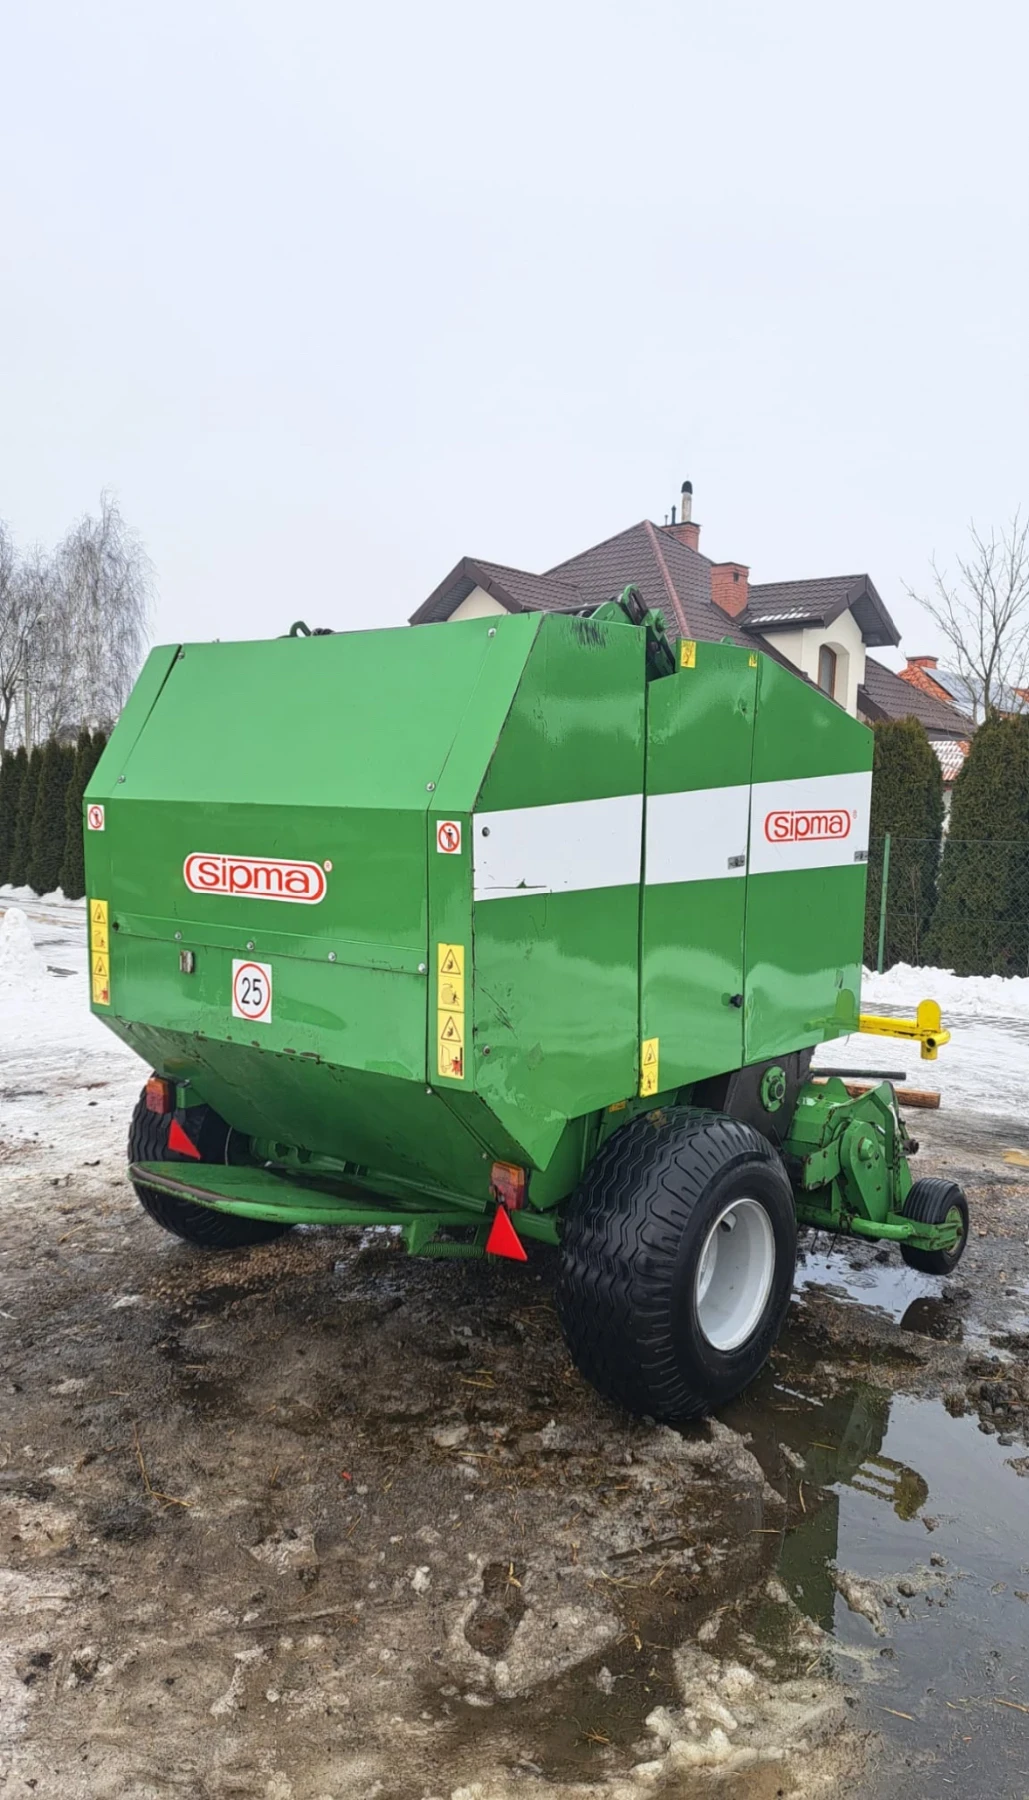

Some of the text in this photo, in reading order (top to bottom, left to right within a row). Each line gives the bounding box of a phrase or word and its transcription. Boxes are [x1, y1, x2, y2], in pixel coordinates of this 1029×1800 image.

[774, 811, 843, 841] sipma
[198, 857, 309, 894] sipma
[241, 977, 262, 1006] 25
